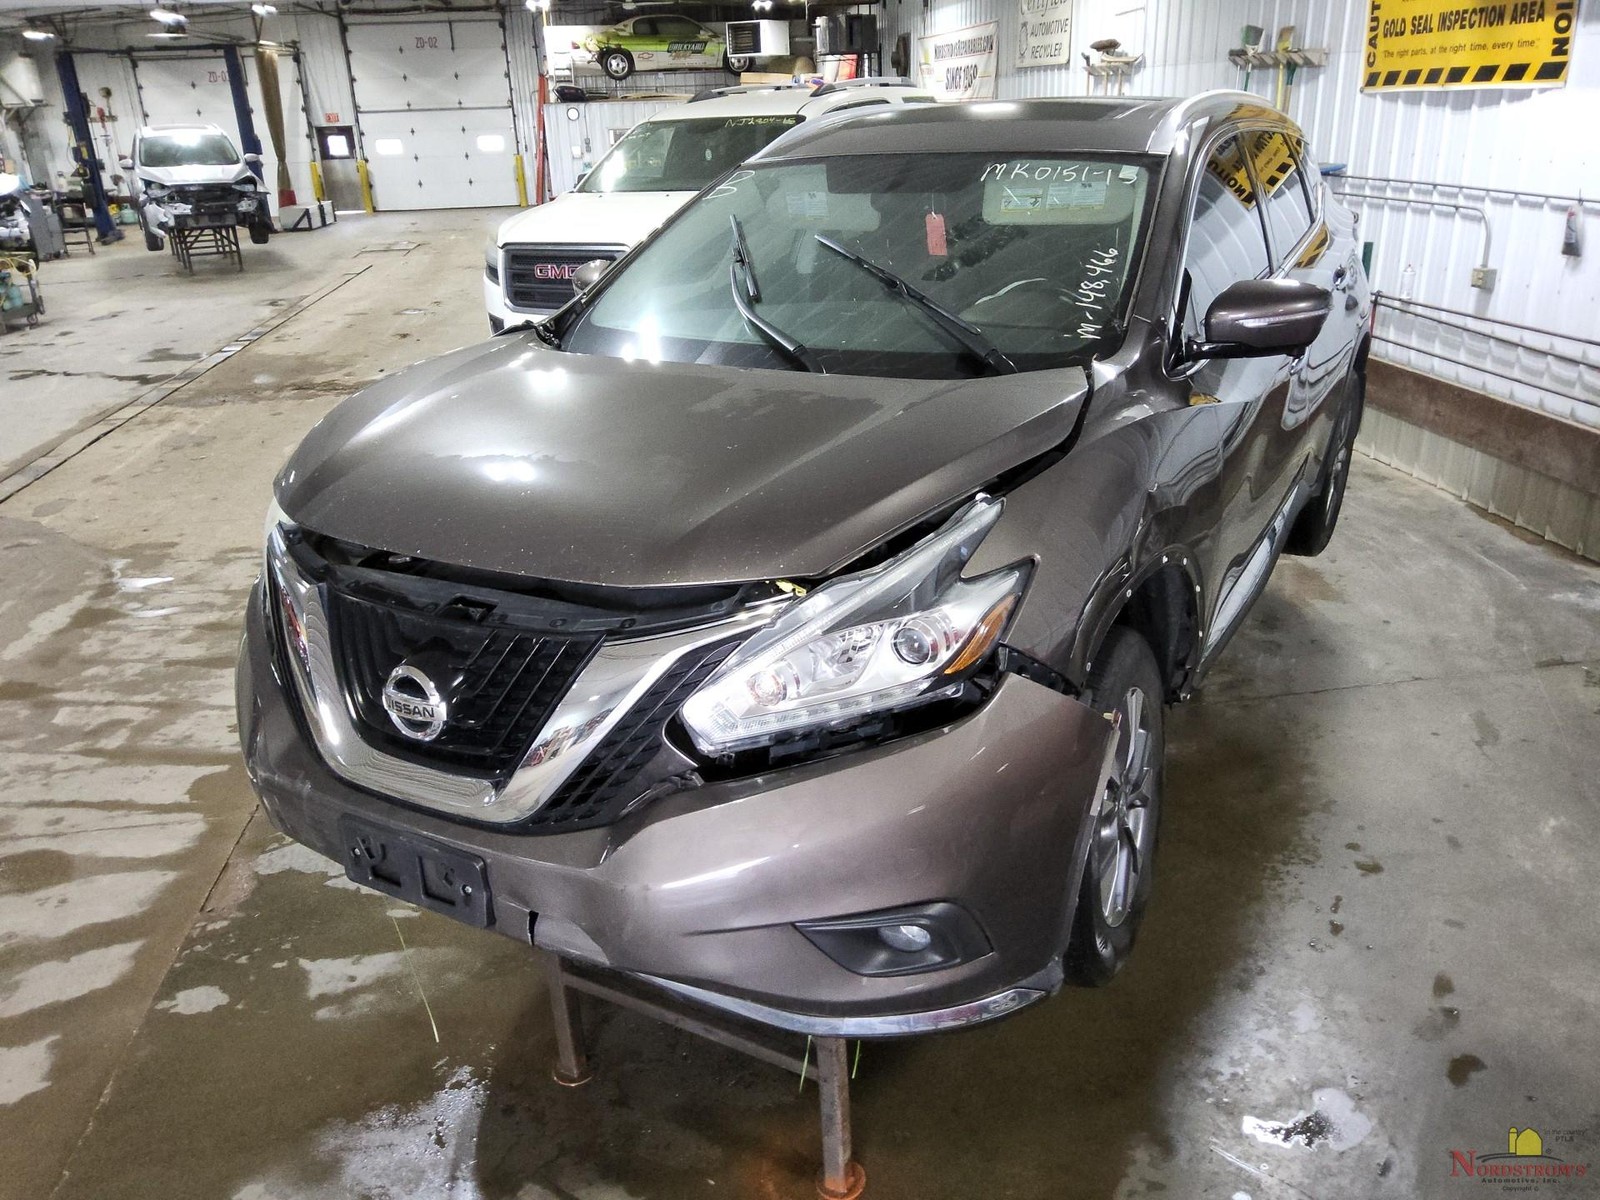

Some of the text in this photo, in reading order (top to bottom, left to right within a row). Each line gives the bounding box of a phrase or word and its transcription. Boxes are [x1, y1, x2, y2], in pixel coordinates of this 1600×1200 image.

[1030, 18, 1069, 37] AUTOMOTIVE
[1383, 1, 1545, 38] GOLD SEAL INSPECTION AREA
[1031, 42, 1062, 59] RECYCLER
[1449, 44, 1466, 55] right
[1492, 41, 1514, 51] every
[207, 70, 228, 83] ZD-0
